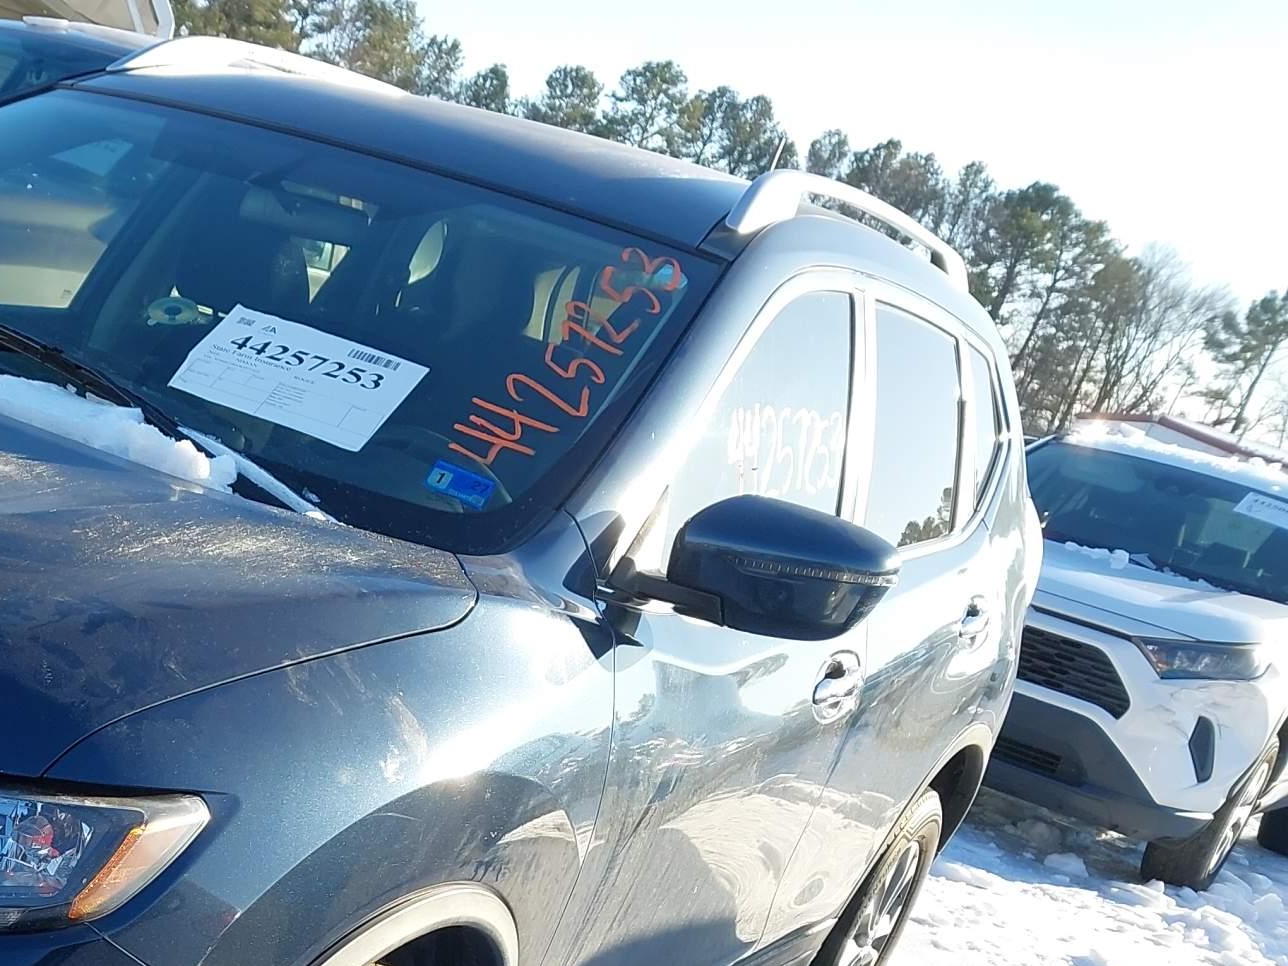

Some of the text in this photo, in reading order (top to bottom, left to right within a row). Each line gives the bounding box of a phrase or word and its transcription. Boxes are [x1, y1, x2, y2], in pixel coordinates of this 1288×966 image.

[230, 335, 385, 390] 44257253
[448, 247, 682, 466] 44257253
[436, 472, 446, 484] 1
